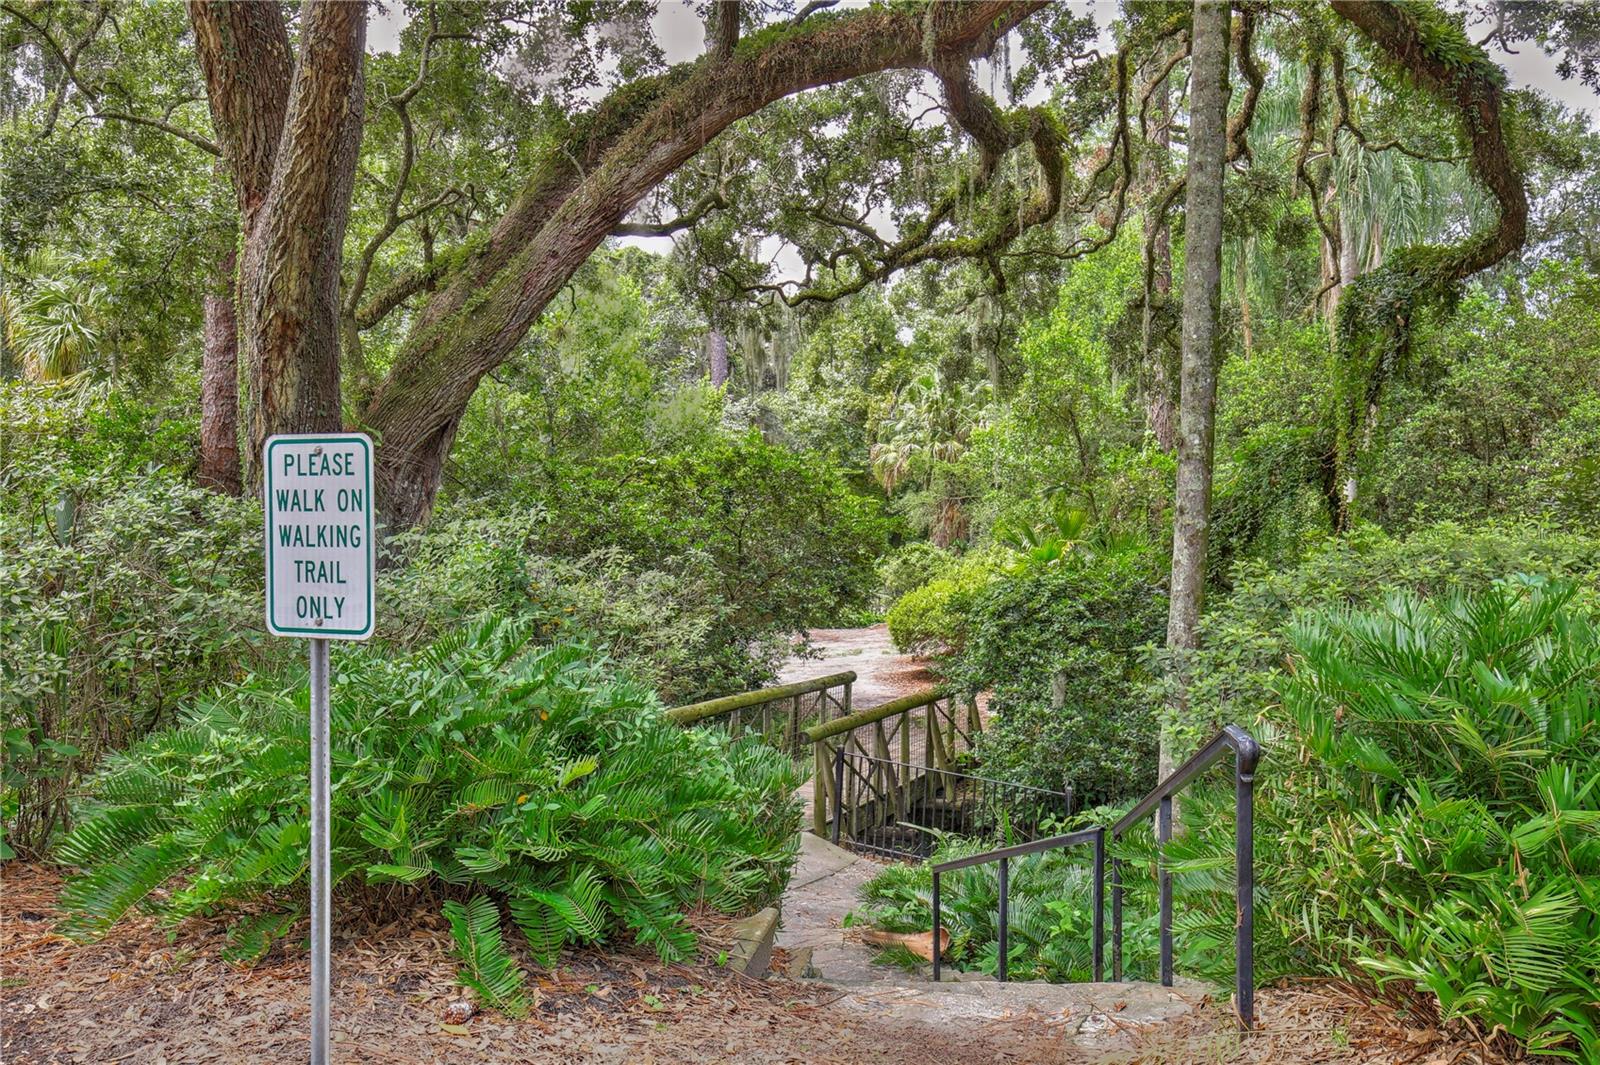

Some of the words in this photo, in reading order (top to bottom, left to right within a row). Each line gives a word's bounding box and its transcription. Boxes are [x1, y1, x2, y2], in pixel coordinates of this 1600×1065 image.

[283, 452, 355, 476] PLEASE
[276, 488, 326, 512] WALK
[336, 488, 363, 512] ON
[278, 524, 361, 548] WALKING
[293, 560, 347, 584] TRAIL
[296, 595, 345, 619] ONLY
